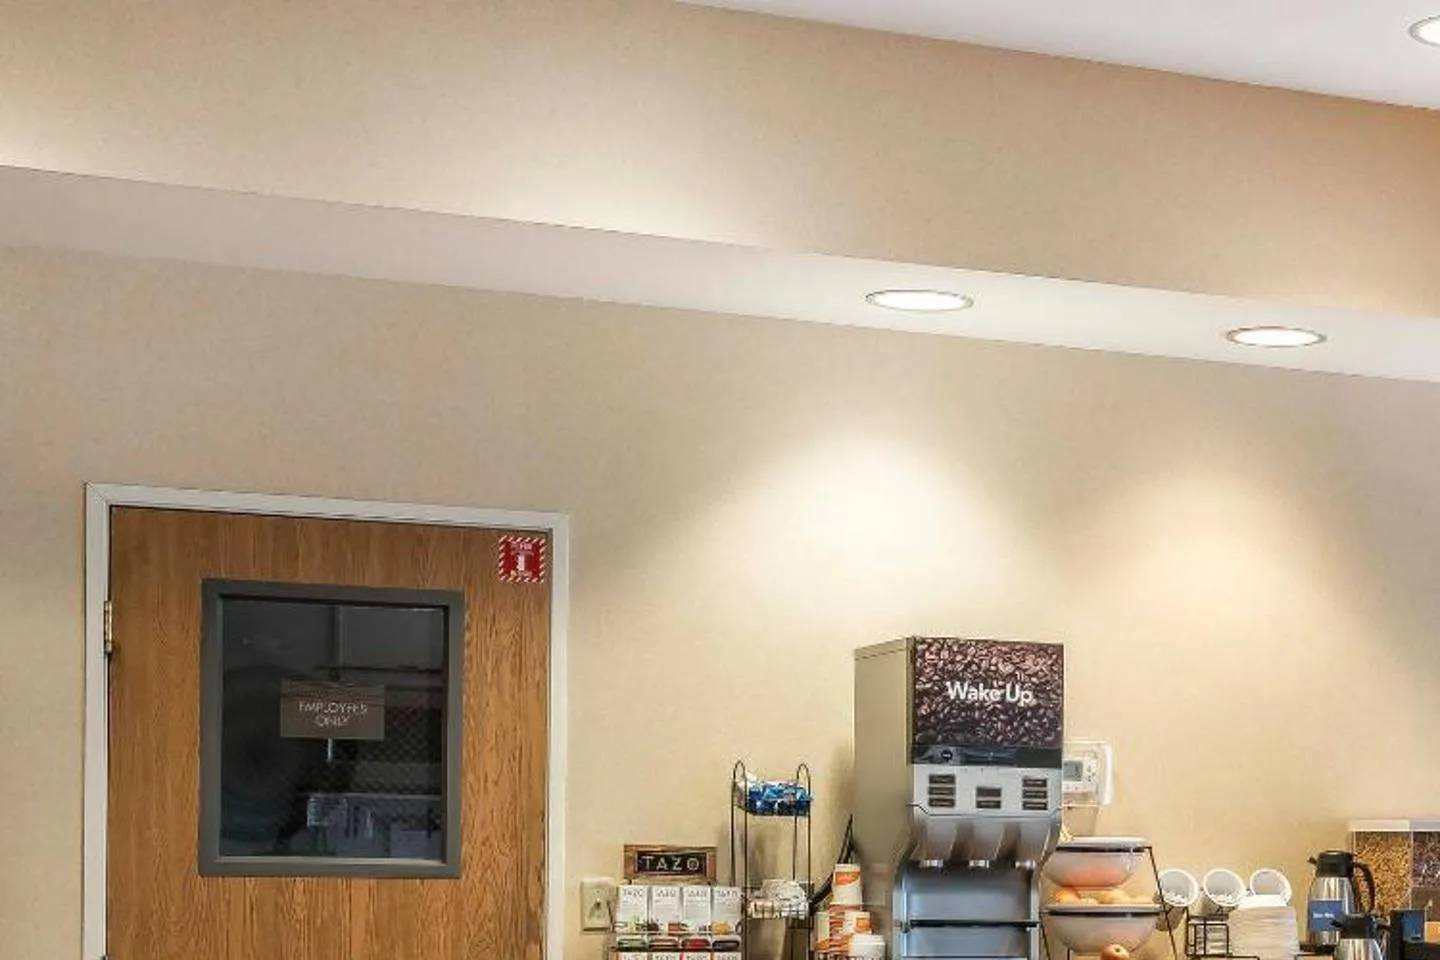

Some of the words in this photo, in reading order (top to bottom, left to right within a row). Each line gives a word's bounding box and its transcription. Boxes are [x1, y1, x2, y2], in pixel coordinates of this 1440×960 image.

[946, 681, 1002, 701] Wake
[1006, 682, 1034, 707] Up
[316, 716, 349, 727] ONLY
[641, 856, 700, 871] TAZO
